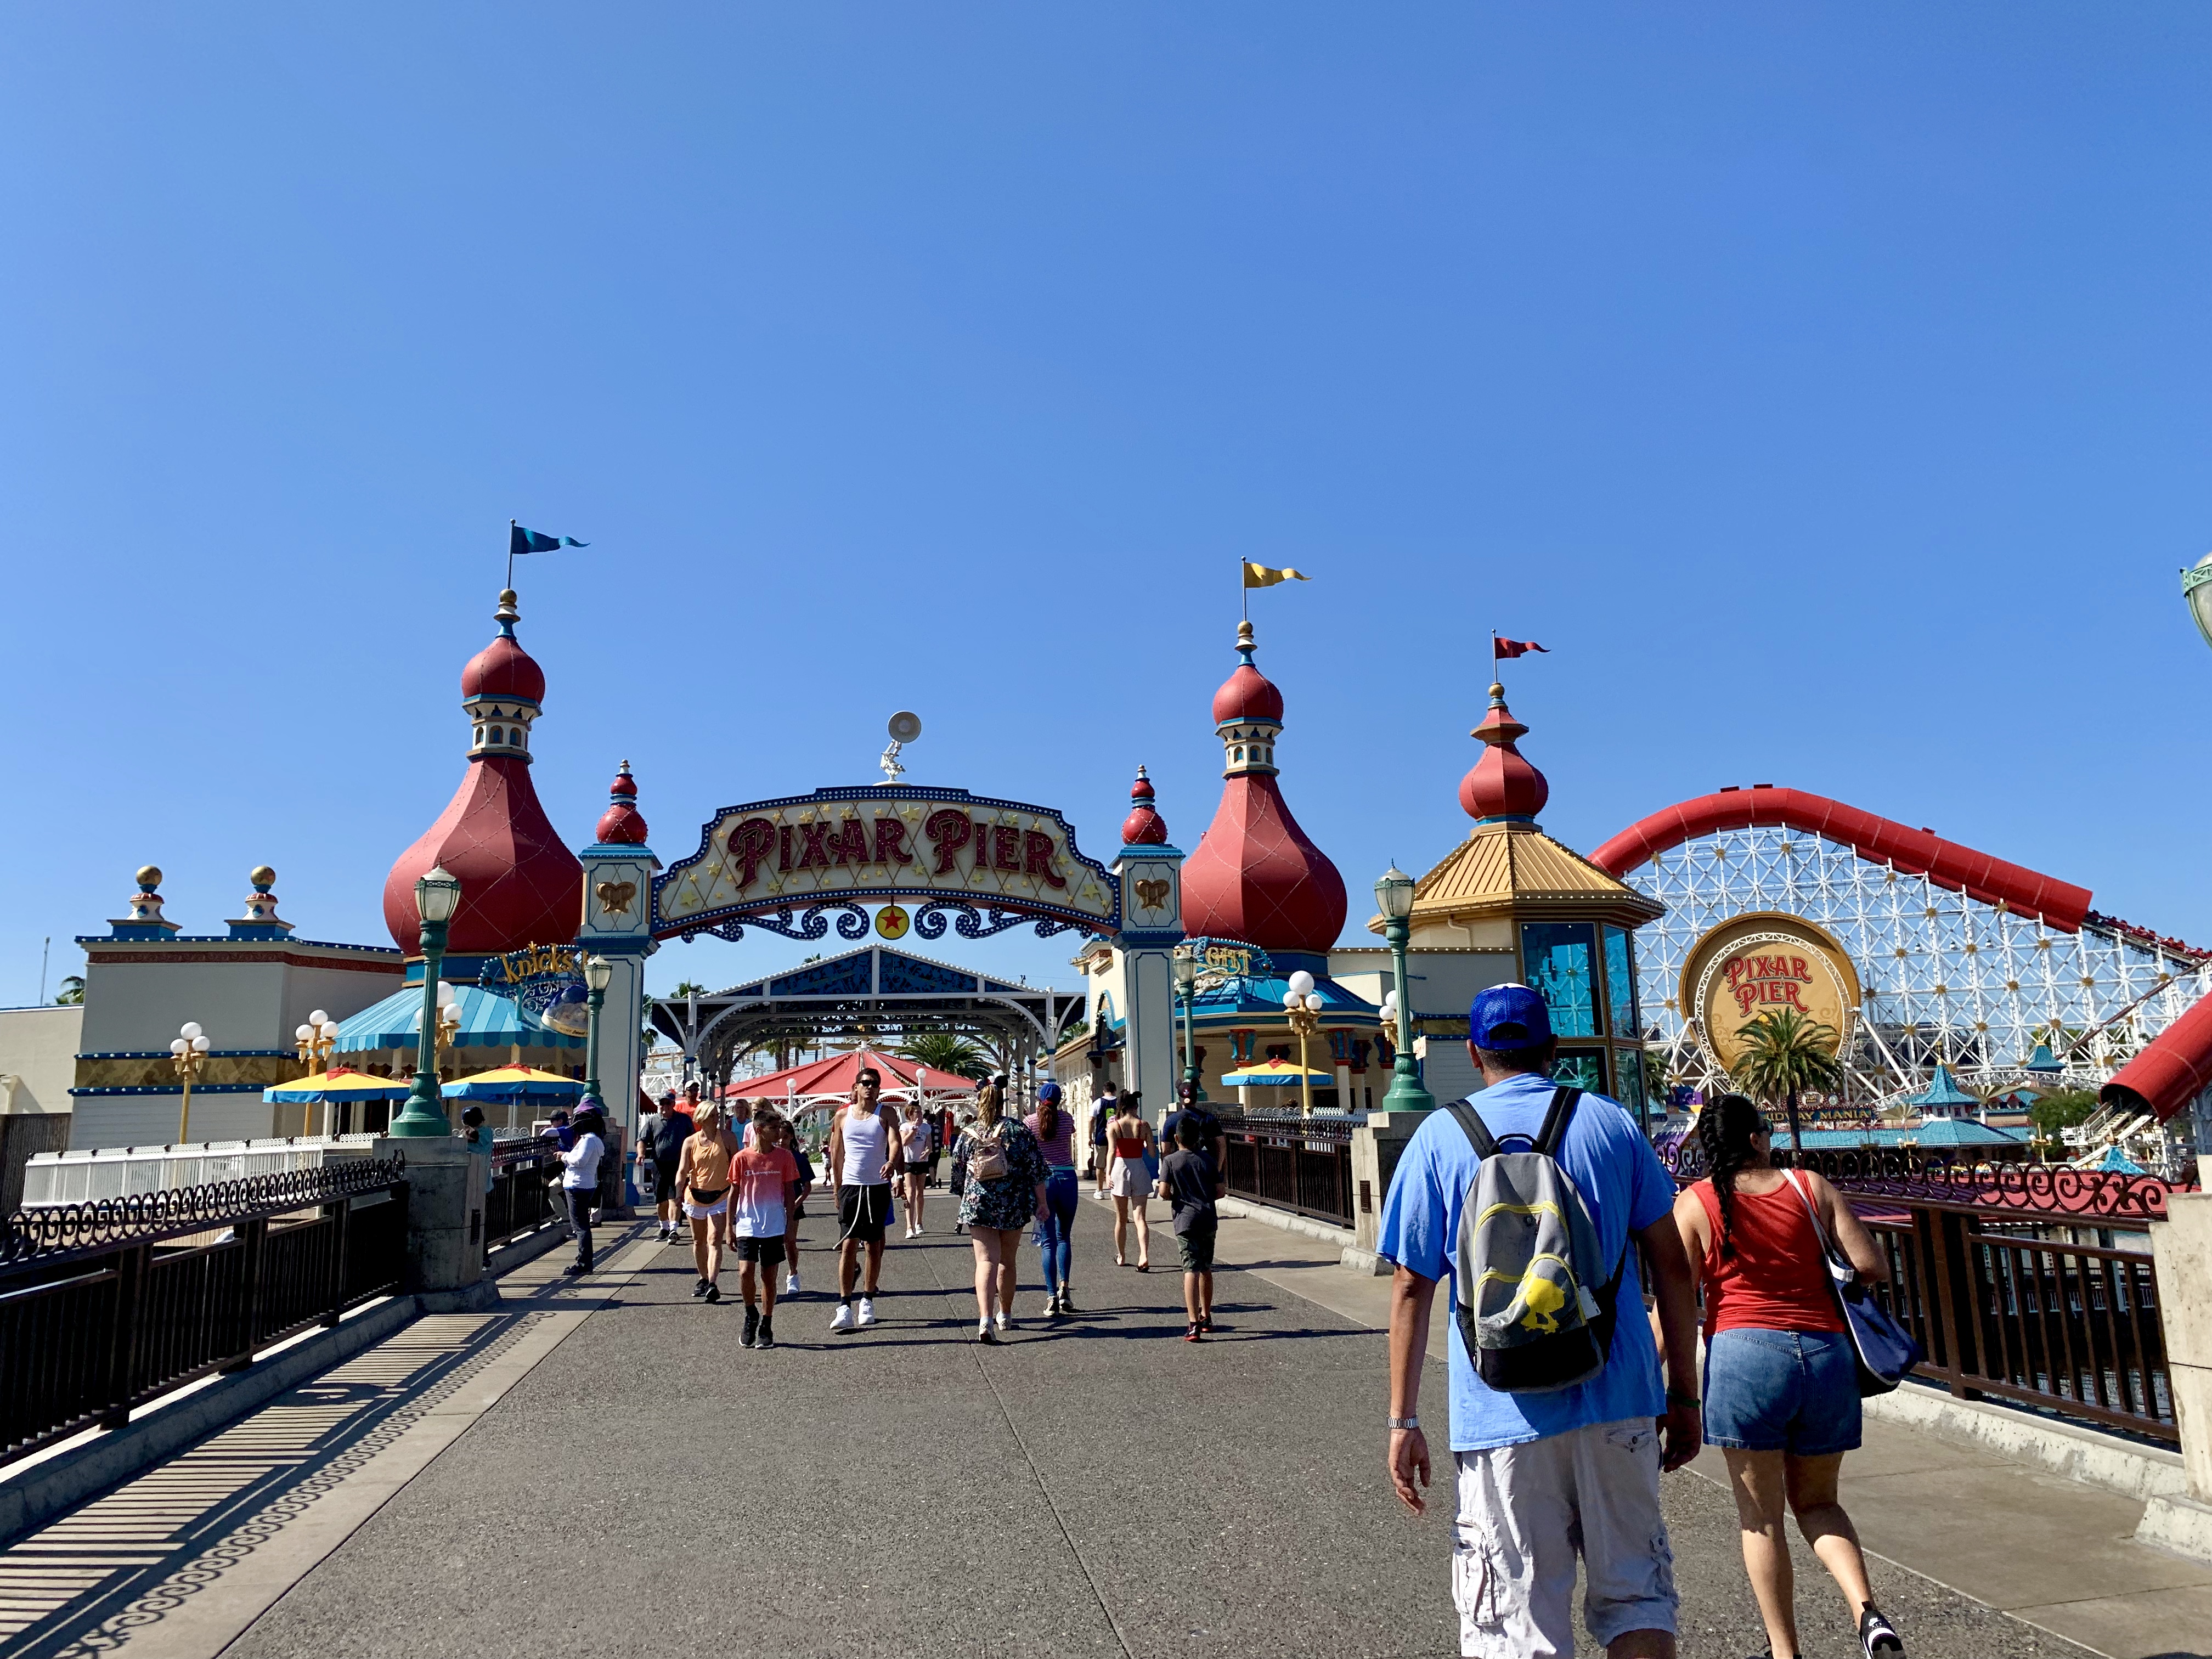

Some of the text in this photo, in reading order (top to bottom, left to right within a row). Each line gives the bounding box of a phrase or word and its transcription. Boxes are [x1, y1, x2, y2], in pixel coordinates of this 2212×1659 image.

[727, 809, 1066, 890] PIXAR PIER
[1723, 955, 1813, 991] PIXAR
[1734, 980, 1809, 1018] PIER
[1820, 1110, 1870, 1120] MANIA
